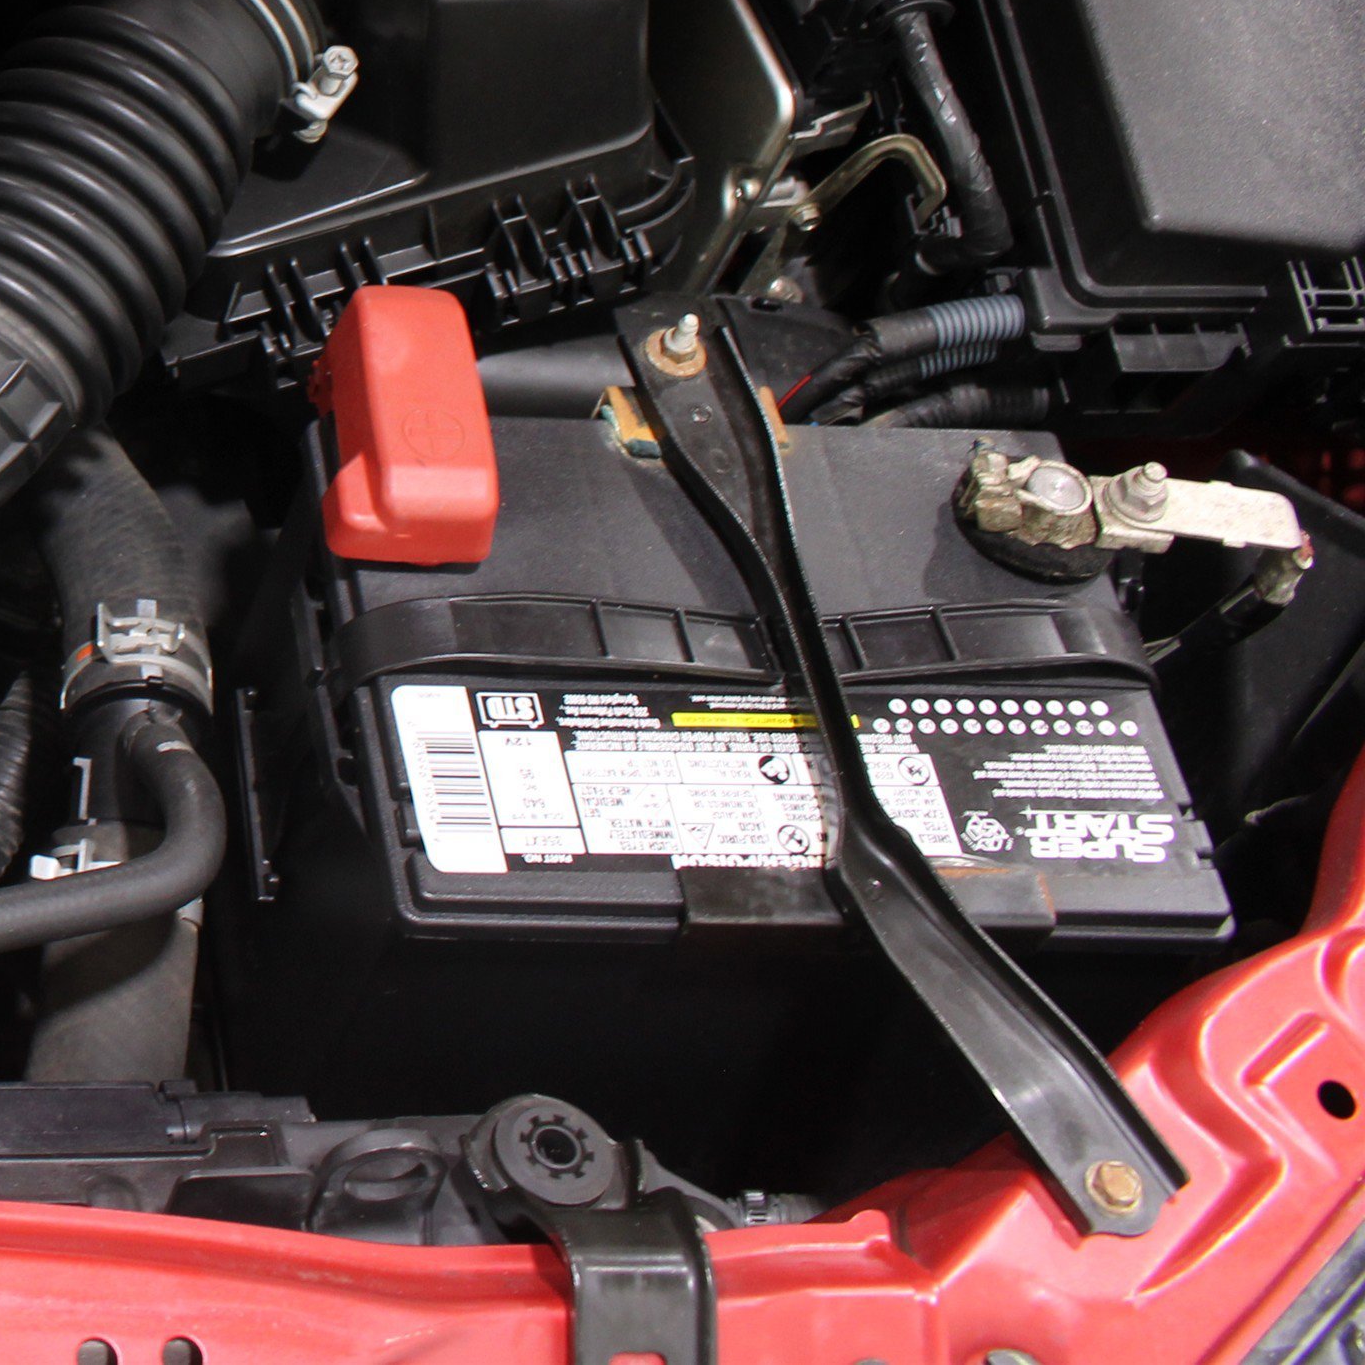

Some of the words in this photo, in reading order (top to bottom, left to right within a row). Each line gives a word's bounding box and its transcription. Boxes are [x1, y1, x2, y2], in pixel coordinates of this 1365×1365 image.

[486, 696, 535, 721] STD
[1025, 814, 1174, 843] START
[1029, 837, 1166, 863] SUPER
